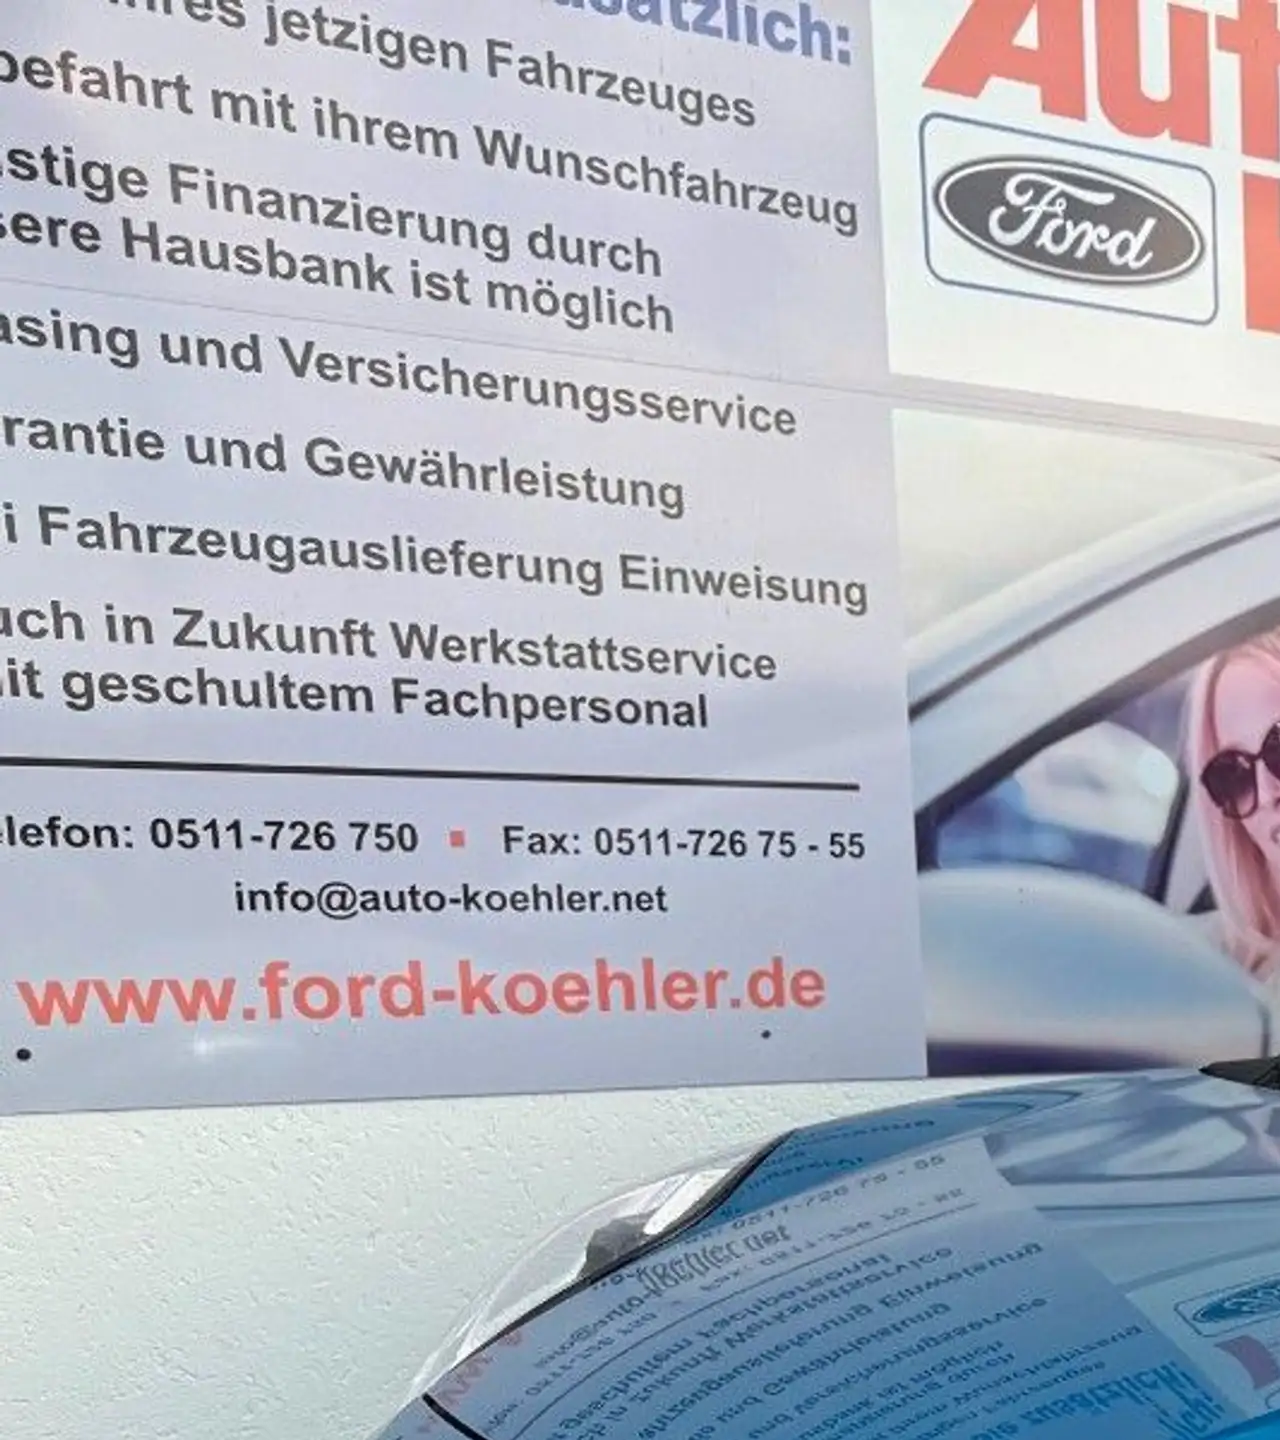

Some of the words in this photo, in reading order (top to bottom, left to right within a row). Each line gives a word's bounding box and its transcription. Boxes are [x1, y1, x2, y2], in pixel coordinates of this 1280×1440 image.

[264, 0, 469, 71] jetzigen
[486, 38, 757, 127] Fahrzeuges
[0, 144, 149, 204] stige
[168, 162, 510, 262] Finanzierung
[527, 223, 662, 277] durch
[211, 88, 297, 133] mit
[313, 96, 459, 161] ihrem
[473, 125, 859, 237] Wunschfahrzeug
[988, 171, 1157, 270] Ford
[0, 211, 102, 254] ere
[122, 216, 394, 294] Hausbank
[410, 259, 472, 306] ist
[487, 277, 675, 335] möglich
[160, 327, 262, 374] und
[279, 337, 799, 438] Versicherungsservice
[2, 413, 166, 463] rantie
[185, 421, 287, 475] und
[304, 438, 686, 519] Gewährleistung
[3, 501, 18, 544] i
[38, 504, 604, 596] Fahrzeugauslieferung
[619, 553, 869, 616] Einweisung
[0, 657, 45, 699] it
[61, 667, 375, 713] geschultem
[393, 678, 710, 729] Fachpersonal
[105, 603, 155, 645] in
[172, 607, 379, 660] Zukunft
[391, 620, 778, 682] Werkstattservice
[0, 815, 134, 848] lefon:
[150, 817, 337, 852] 0511-726
[348, 820, 420, 853] 750
[502, 825, 581, 856] Fax:
[594, 827, 748, 858] 0511-726
[758, 830, 797, 858] 75
[828, 832, 867, 859] 55
[234, 880, 669, 920] info@auto-koehler.net
[15, 956, 827, 1027] www.ford-koehler.de
